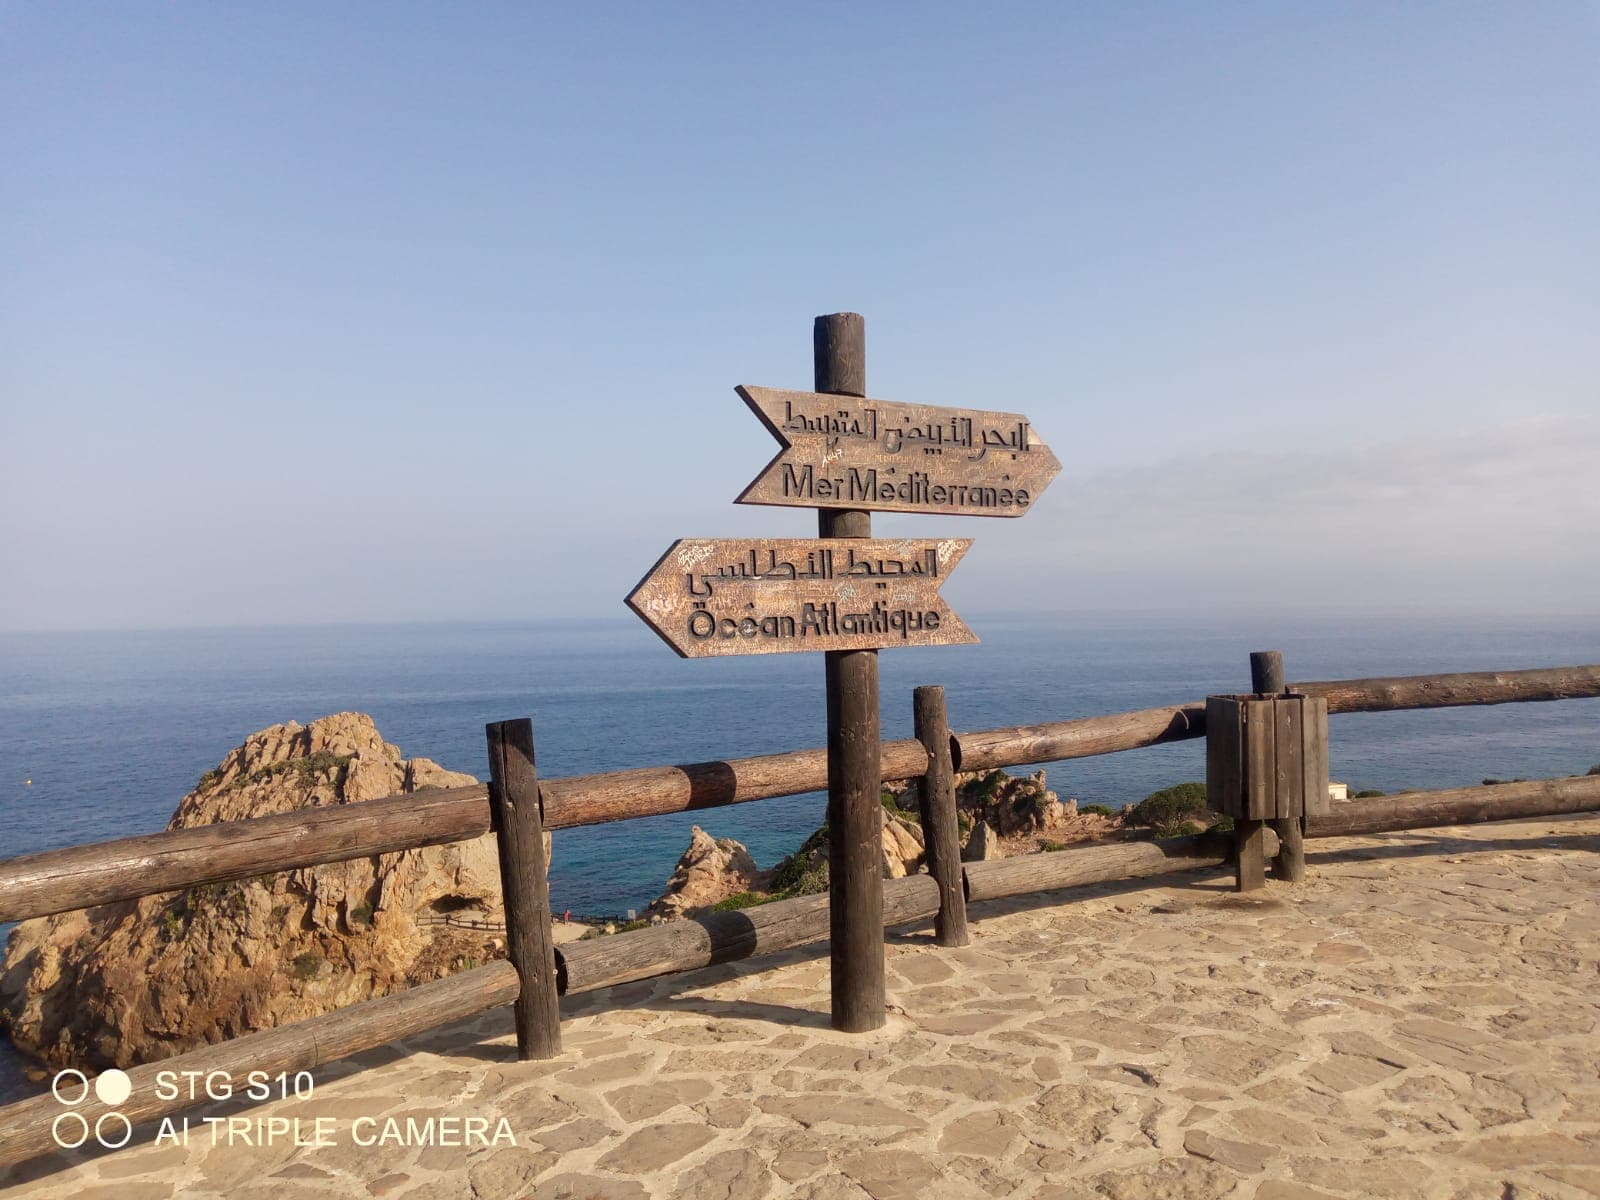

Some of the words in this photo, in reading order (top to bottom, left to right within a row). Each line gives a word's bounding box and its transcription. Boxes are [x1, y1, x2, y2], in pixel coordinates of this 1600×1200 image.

[782, 401, 877, 449] المتوسط
[882, 416, 972, 454] الأبيض
[968, 421, 1030, 461] البحر
[782, 463, 844, 499] Mer
[848, 467, 1030, 507] Méditerranée
[686, 549, 835, 609] الأطلسي
[837, 549, 937, 589] المحيط
[800, 601, 940, 639] Atlantique
